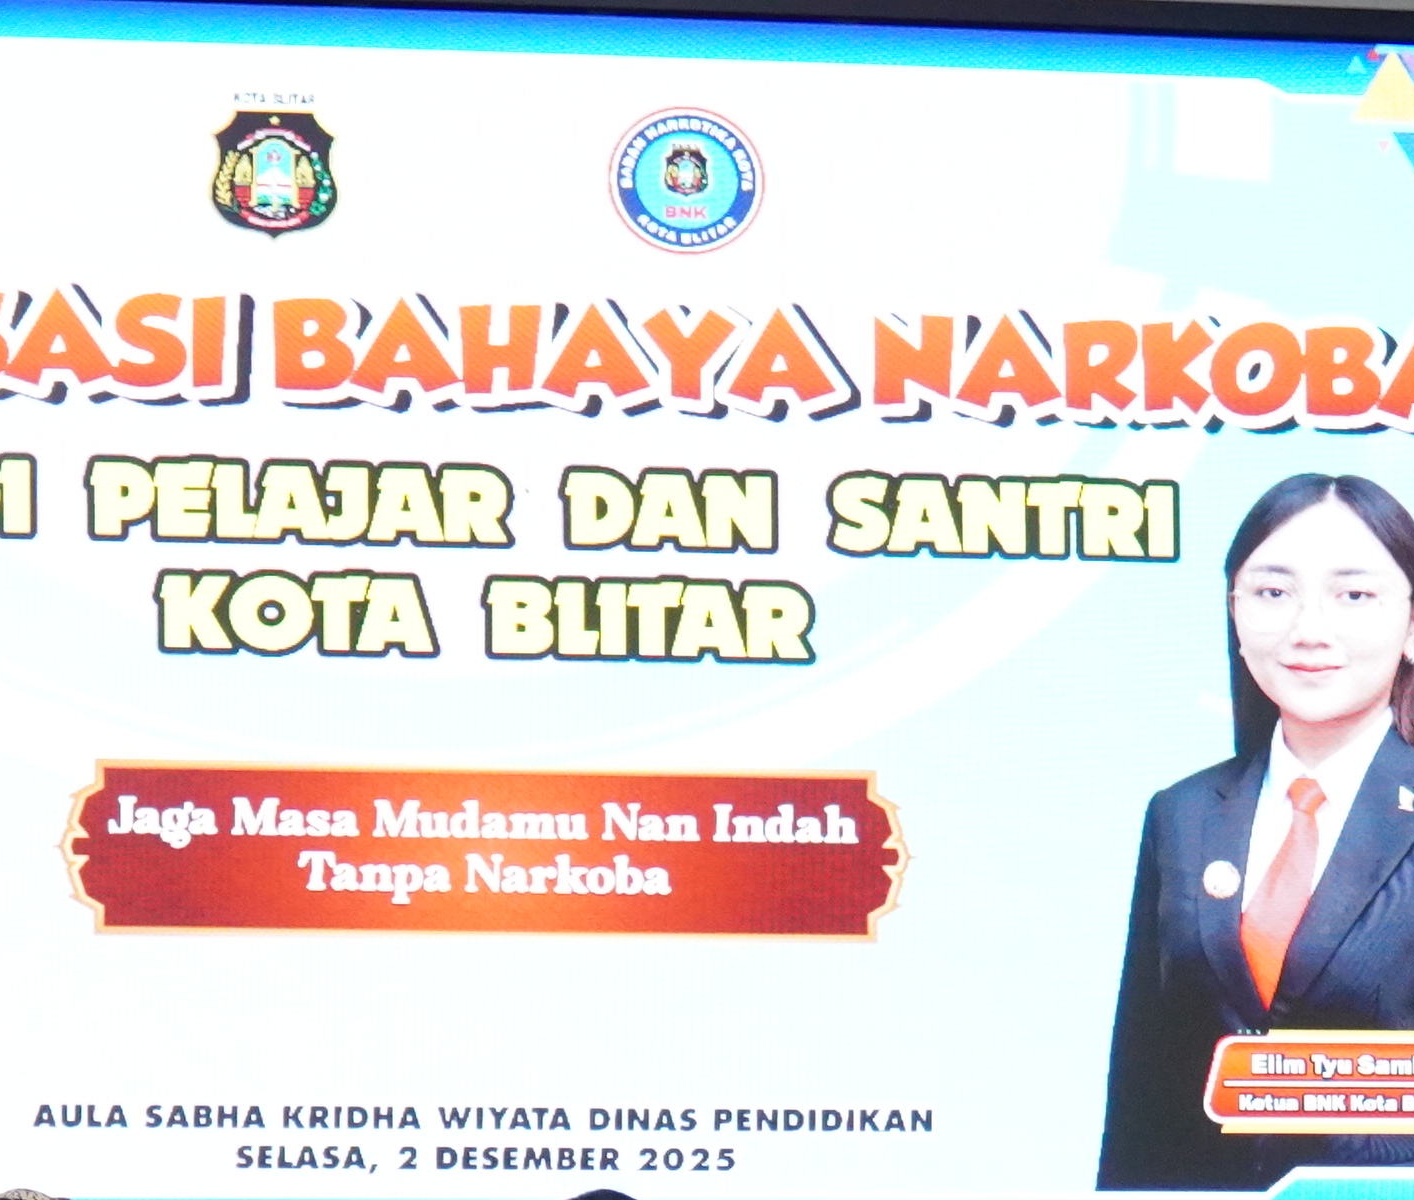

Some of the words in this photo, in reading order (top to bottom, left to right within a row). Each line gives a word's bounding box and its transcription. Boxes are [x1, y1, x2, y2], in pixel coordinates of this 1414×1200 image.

[619, 136, 647, 189] BADAN
[643, 117, 737, 151] NARKOTIKA
[637, 214, 678, 243] KOTA
[680, 216, 737, 245] BLITAR
[665, 205, 707, 219] BNK
[272, 296, 845, 410] BAHAYA
[84, 454, 515, 547] PELAJAR
[559, 465, 778, 554] DAN
[827, 470, 1179, 561] SANTRI
[154, 569, 440, 656] KOTA
[481, 574, 816, 664] BLITAR
[108, 794, 218, 849] Jaga
[231, 797, 360, 837] Masa
[372, 798, 589, 840] Mudamu
[601, 802, 700, 842] Nan
[712, 803, 859, 843] Indah
[297, 850, 451, 905] Tanpa
[464, 853, 672, 895] Narkoba
[1250, 1053, 1307, 1076] Elim
[1310, 1053, 1353, 1079] Tyu
[33, 1104, 128, 1128] AULA
[145, 1104, 266, 1129] SABHA
[283, 1106, 421, 1129] KRIDHA
[438, 1106, 572, 1130] WIYATA
[589, 1107, 697, 1131] DINAS
[714, 1108, 933, 1132] PENDIDIKAN
[1238, 1093, 1300, 1112] Ketua
[1302, 1093, 1347, 1112] BNK
[1350, 1094, 1398, 1113] Kota
[236, 1145, 378, 1174] SELASA,
[398, 1146, 418, 1170] 2
[436, 1146, 620, 1171] DESEMBER
[638, 1147, 736, 1172] 2025
